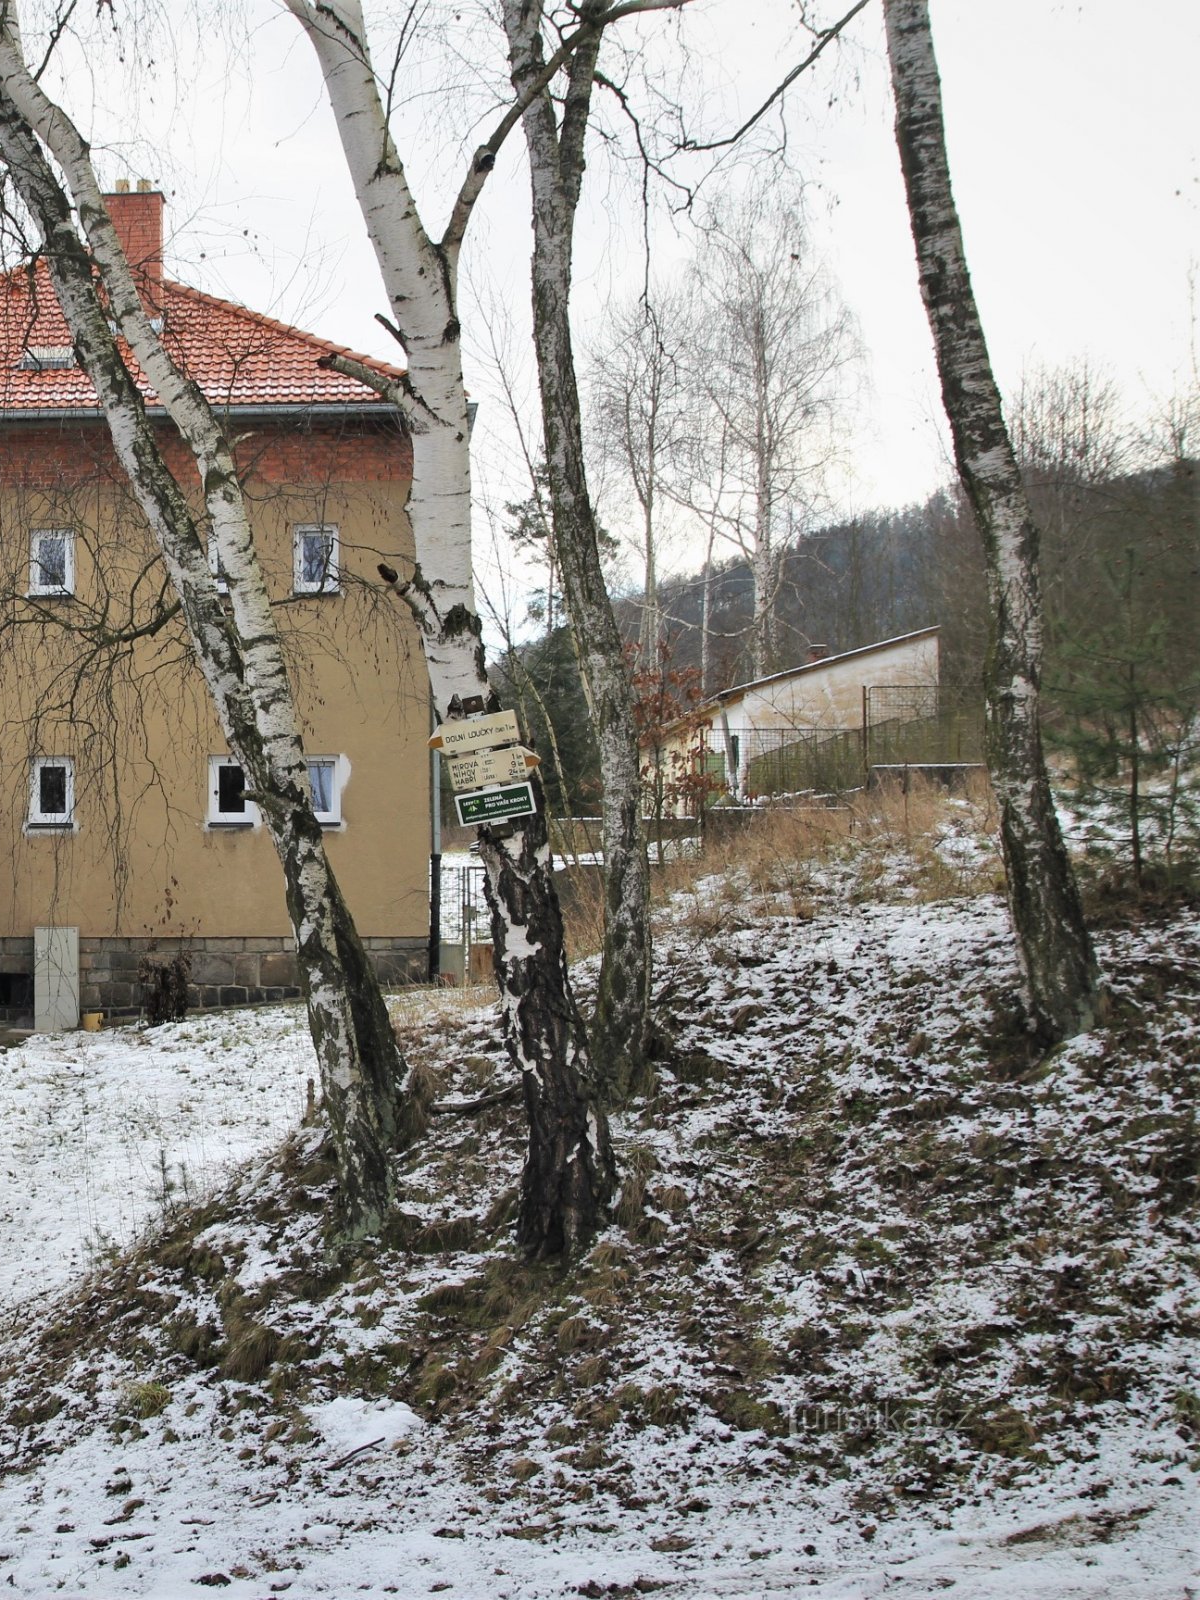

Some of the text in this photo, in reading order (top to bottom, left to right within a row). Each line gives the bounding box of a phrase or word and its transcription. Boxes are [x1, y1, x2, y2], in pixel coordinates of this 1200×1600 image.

[445, 734, 466, 744] DOLNÍ
[468, 727, 494, 739] LOUČKY
[452, 760, 479, 771] MÍROVÁ
[453, 769, 476, 779] NÍHOV
[455, 776, 477, 786] HABŘÍ
[484, 794, 503, 802] ZELENÁ
[510, 795, 528, 804] KROKY
